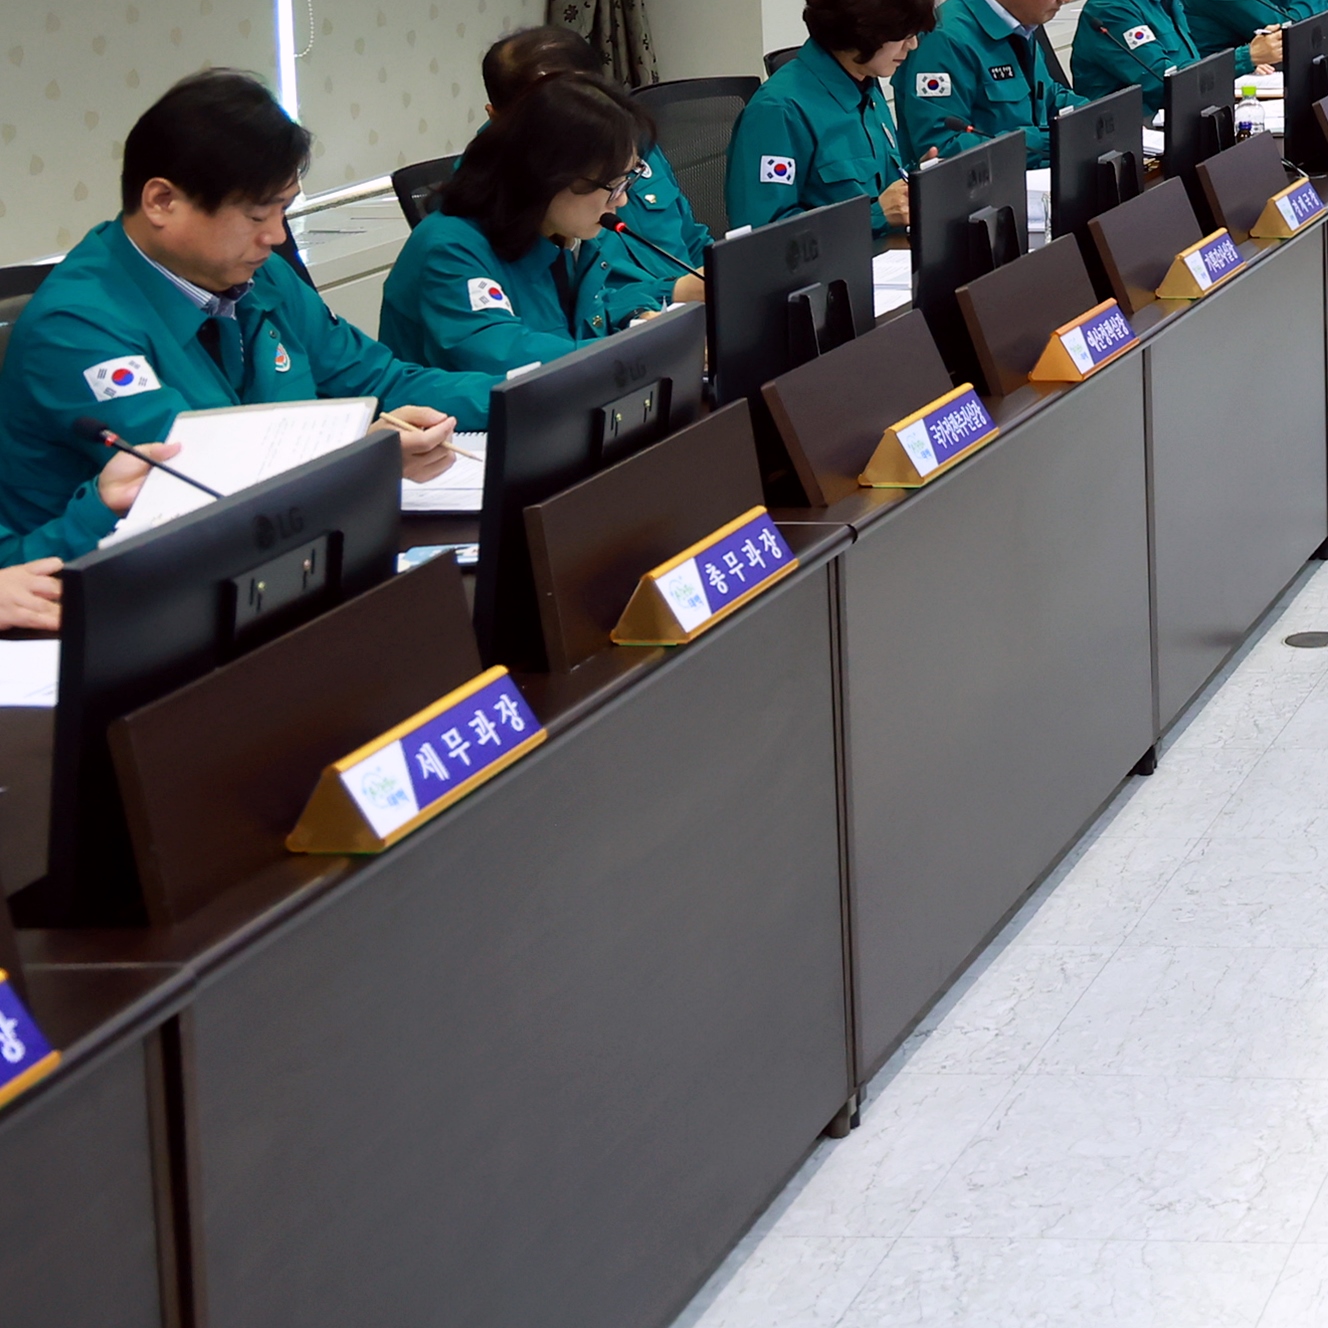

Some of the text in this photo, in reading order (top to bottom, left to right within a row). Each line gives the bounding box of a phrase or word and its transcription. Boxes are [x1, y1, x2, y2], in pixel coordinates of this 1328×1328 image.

[1086, 312, 1130, 352] 예산정책실장
[929, 399, 988, 449] 국가정책추진실장
[704, 527, 783, 594] 총무과장
[414, 692, 527, 782] 세무과장
